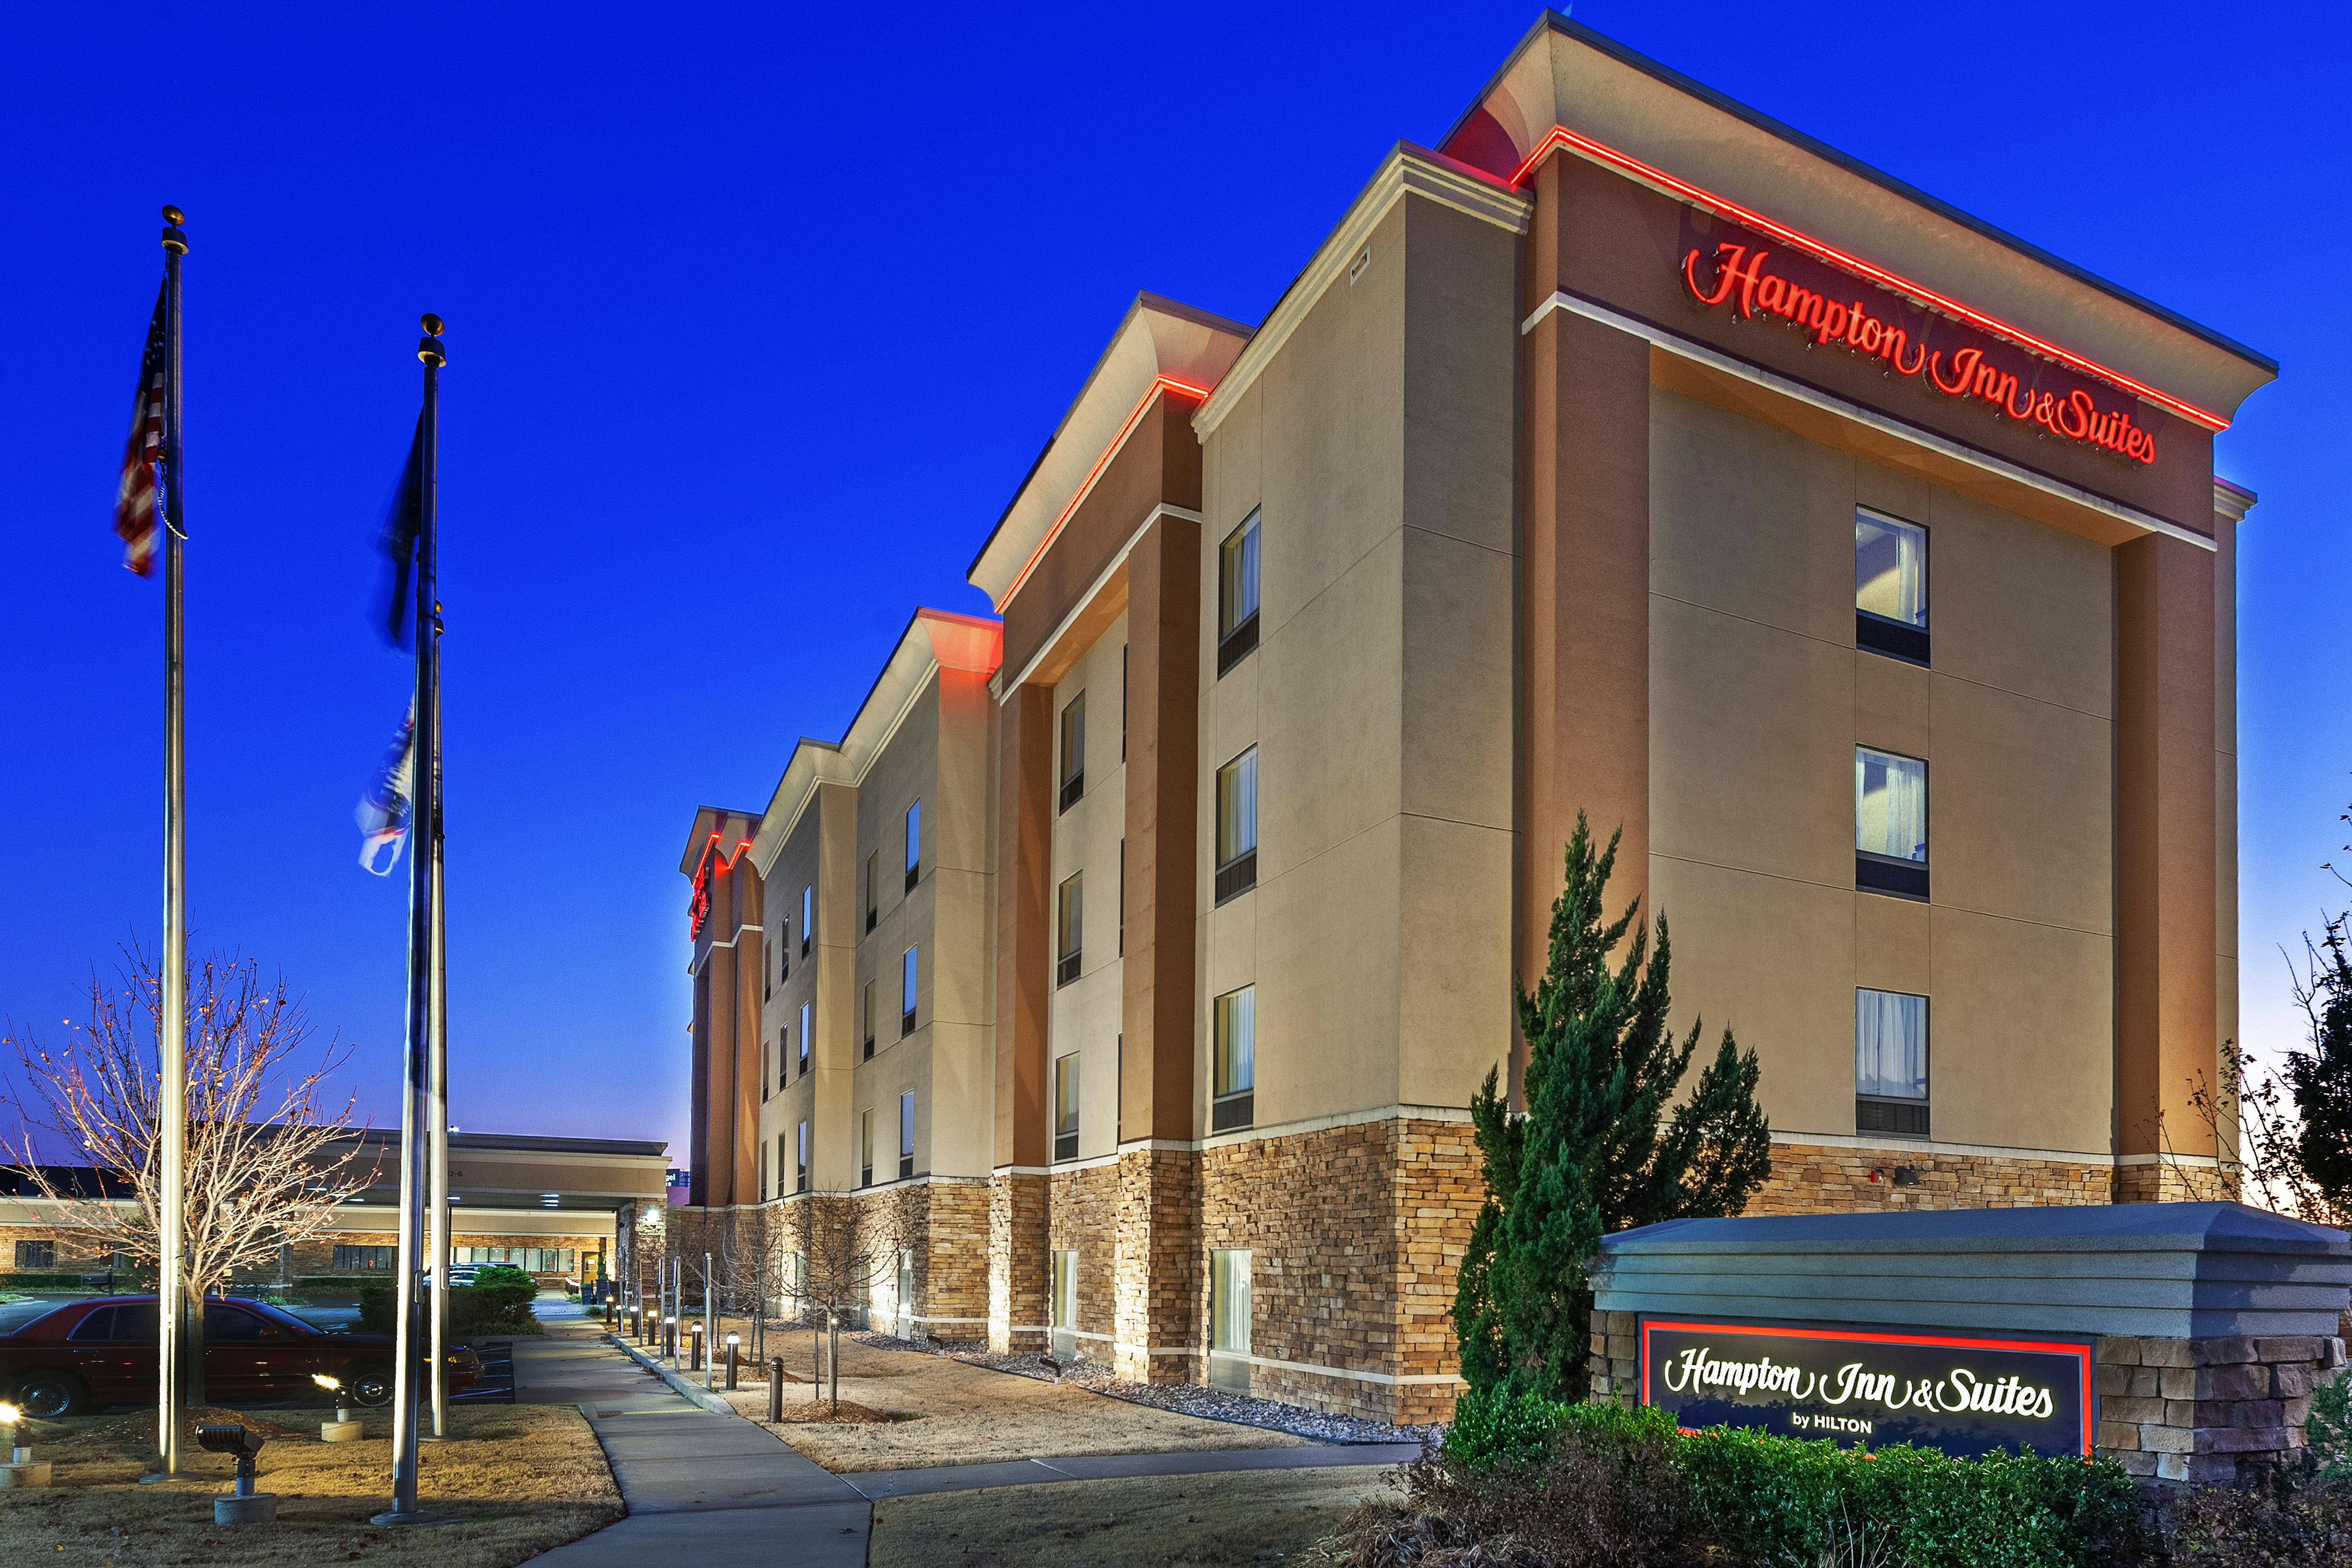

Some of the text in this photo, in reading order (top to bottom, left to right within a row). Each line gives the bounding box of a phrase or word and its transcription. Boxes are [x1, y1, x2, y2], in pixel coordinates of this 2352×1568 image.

[1686, 242, 1926, 375] Hampton
[1930, 347, 2037, 420] Inn
[2056, 389, 2156, 465] Suites
[1664, 1346, 1816, 1399] Hampton
[1818, 1362, 1913, 1410] Inn
[1935, 1368, 2054, 1418] Suites
[1792, 1412, 1872, 1434] by HILTON
